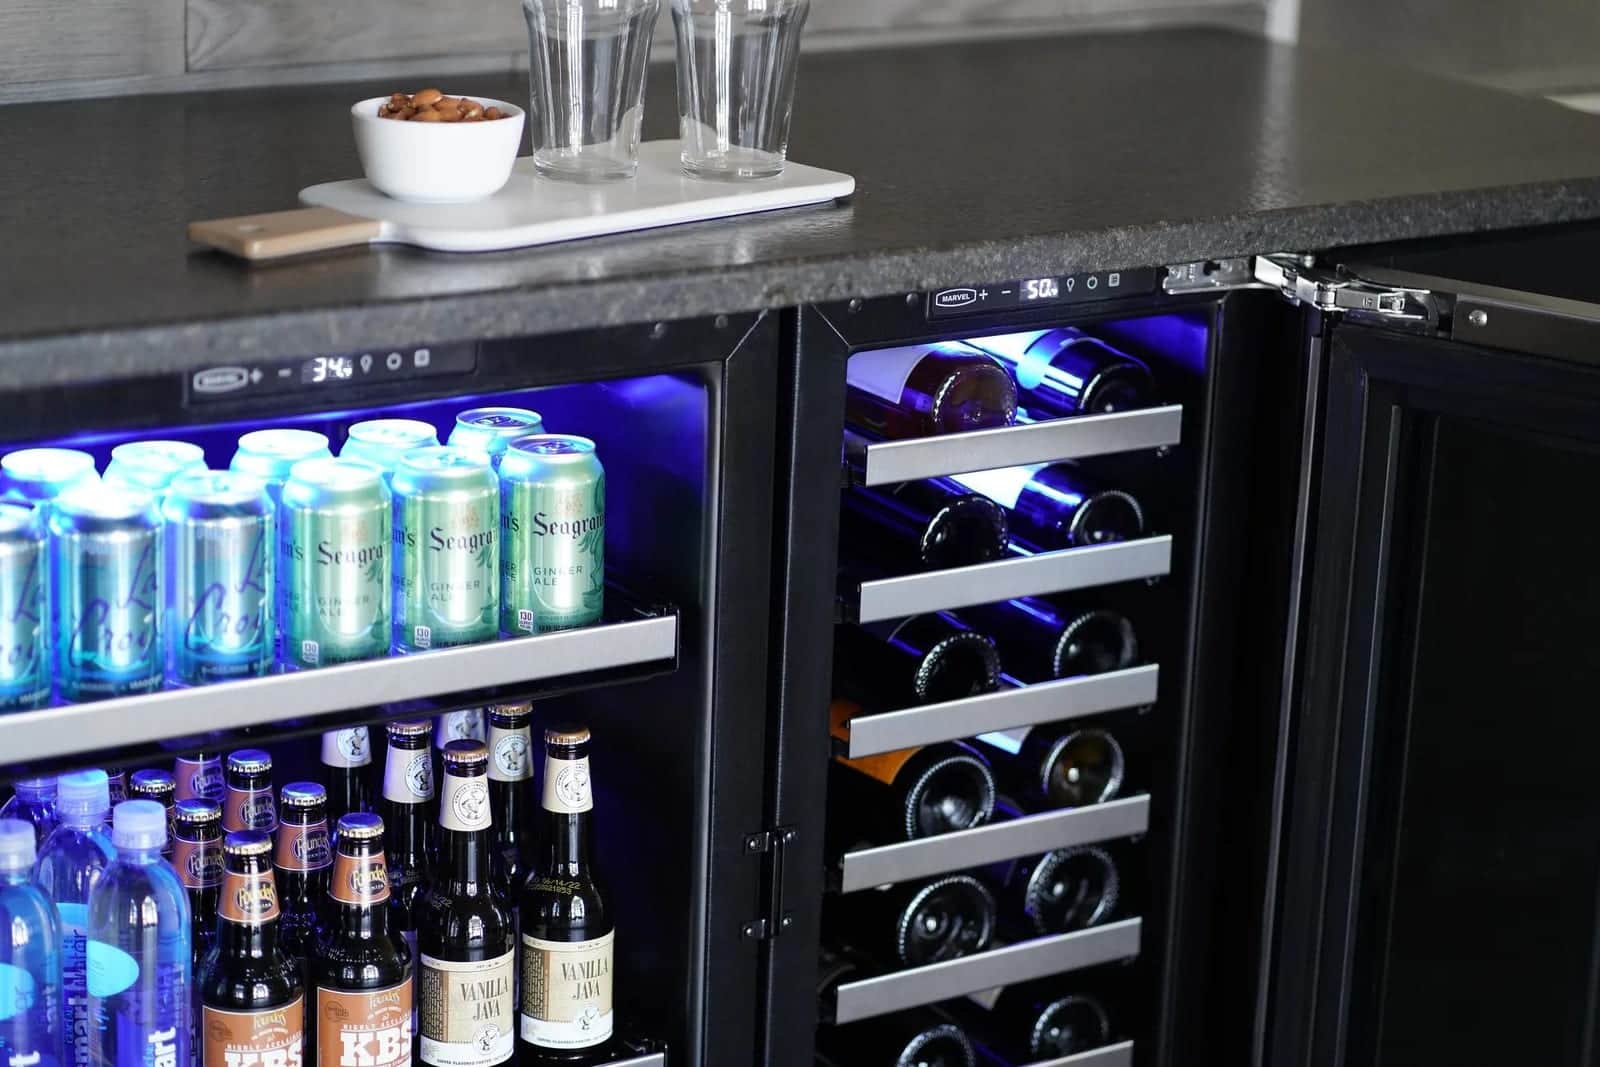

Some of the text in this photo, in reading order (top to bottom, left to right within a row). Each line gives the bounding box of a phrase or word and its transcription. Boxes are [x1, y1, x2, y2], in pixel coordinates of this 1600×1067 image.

[942, 293, 970, 302] MARVEL
[429, 527, 495, 554] Seagra
[534, 565, 583, 577] GINER
[431, 579, 481, 592] GINER
[561, 957, 609, 981] VANILLA
[461, 975, 509, 1001] VANILLA
[573, 980, 601, 1001] JAVA
[473, 1000, 500, 1021] JAVA
